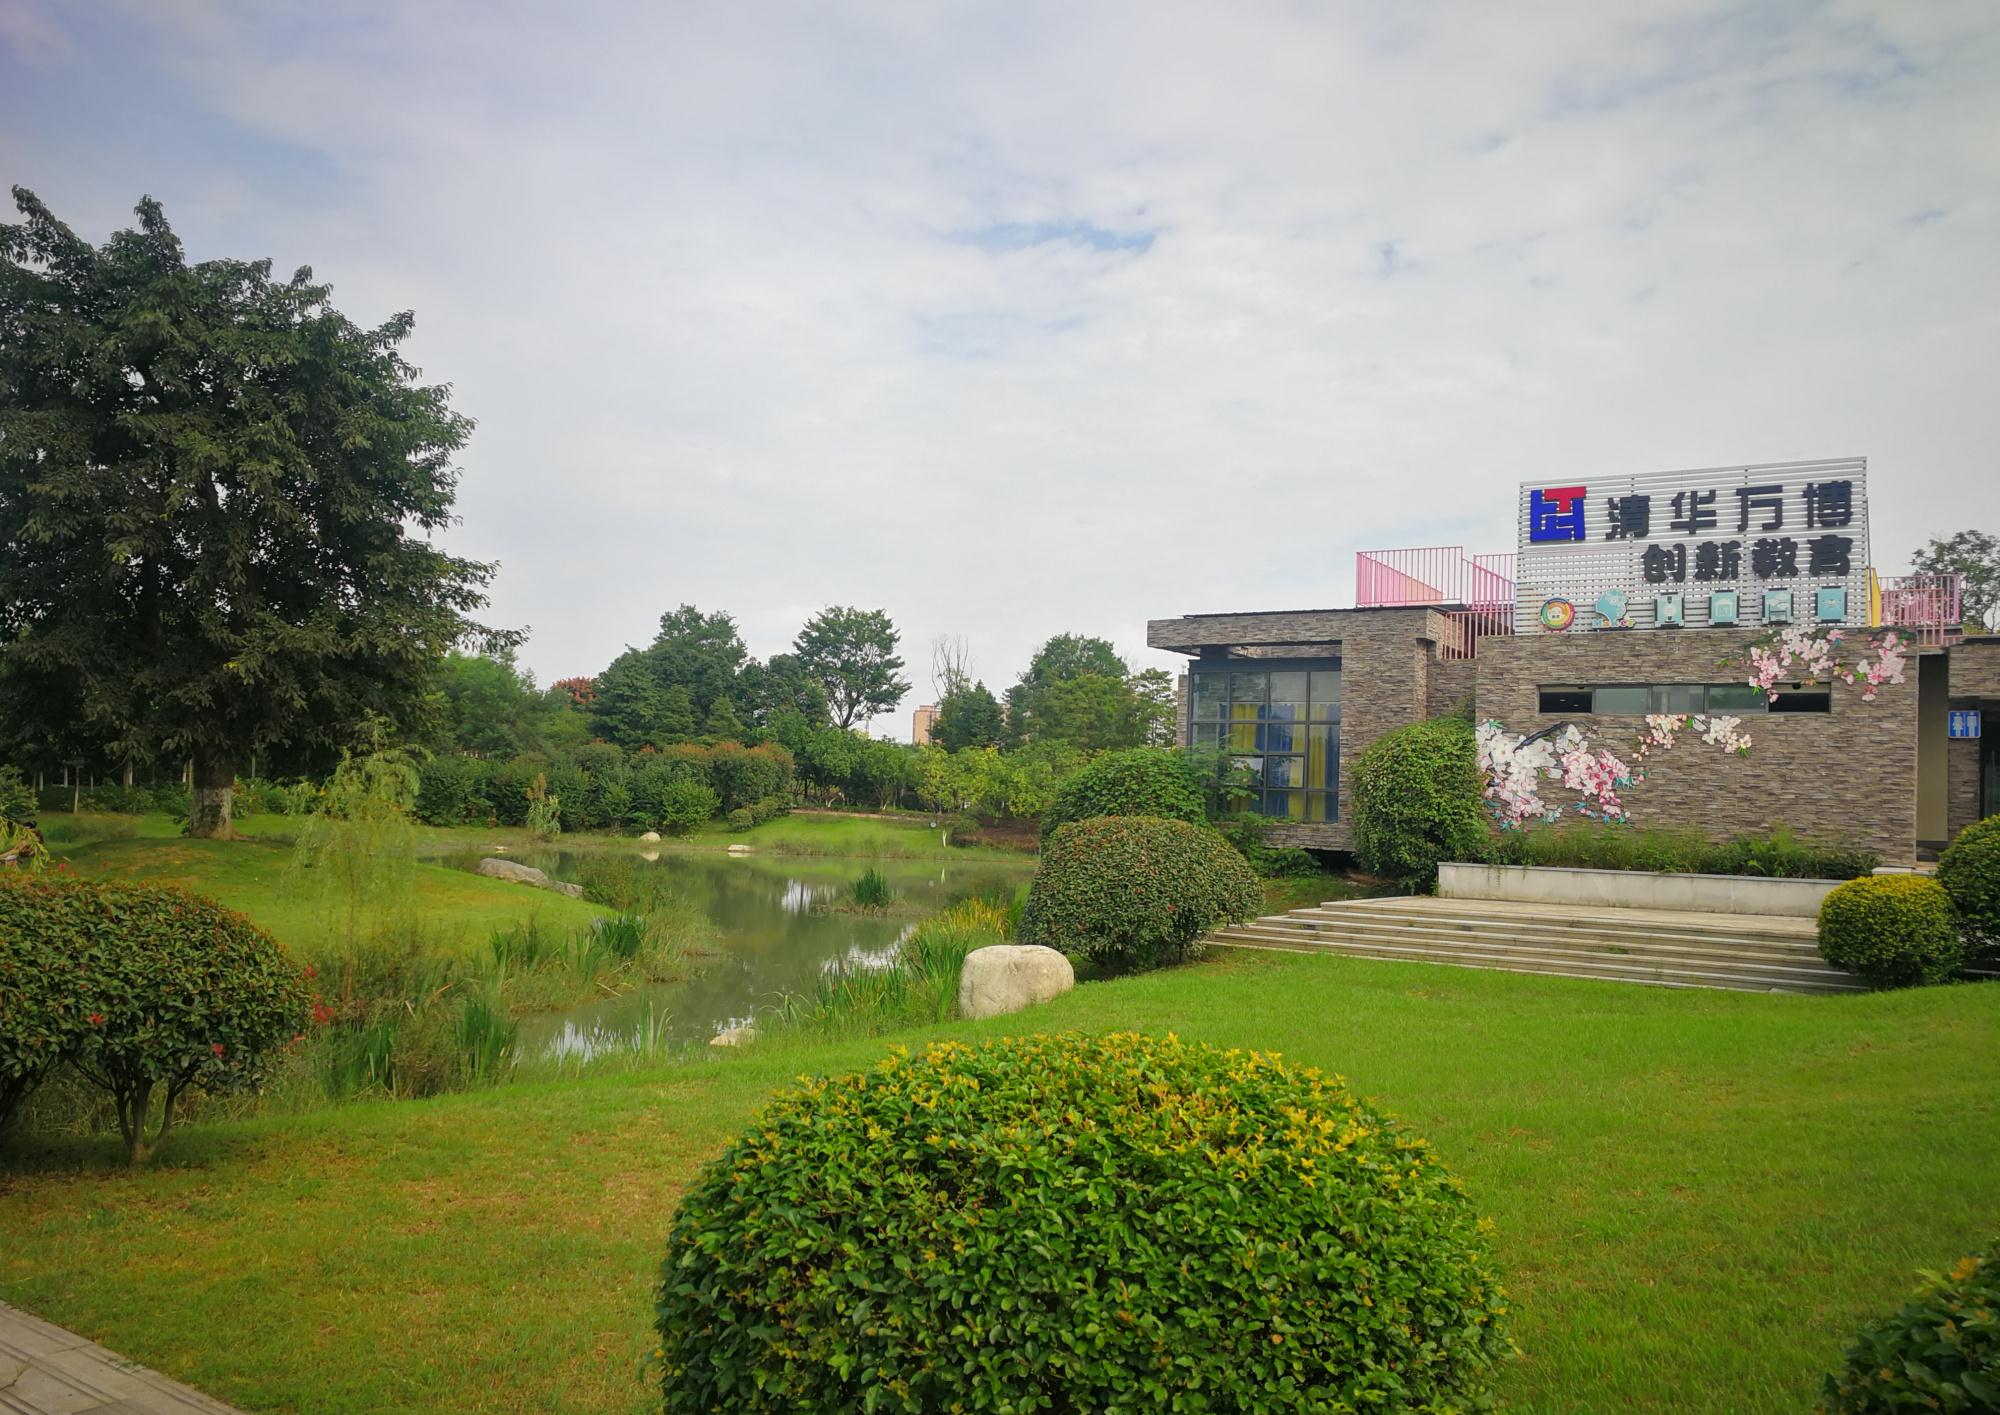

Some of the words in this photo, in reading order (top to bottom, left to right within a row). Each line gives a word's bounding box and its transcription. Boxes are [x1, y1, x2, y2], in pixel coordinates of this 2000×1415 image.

[1605, 481, 1853, 539] 清华万博
[1642, 534, 1854, 582] 创新教育
